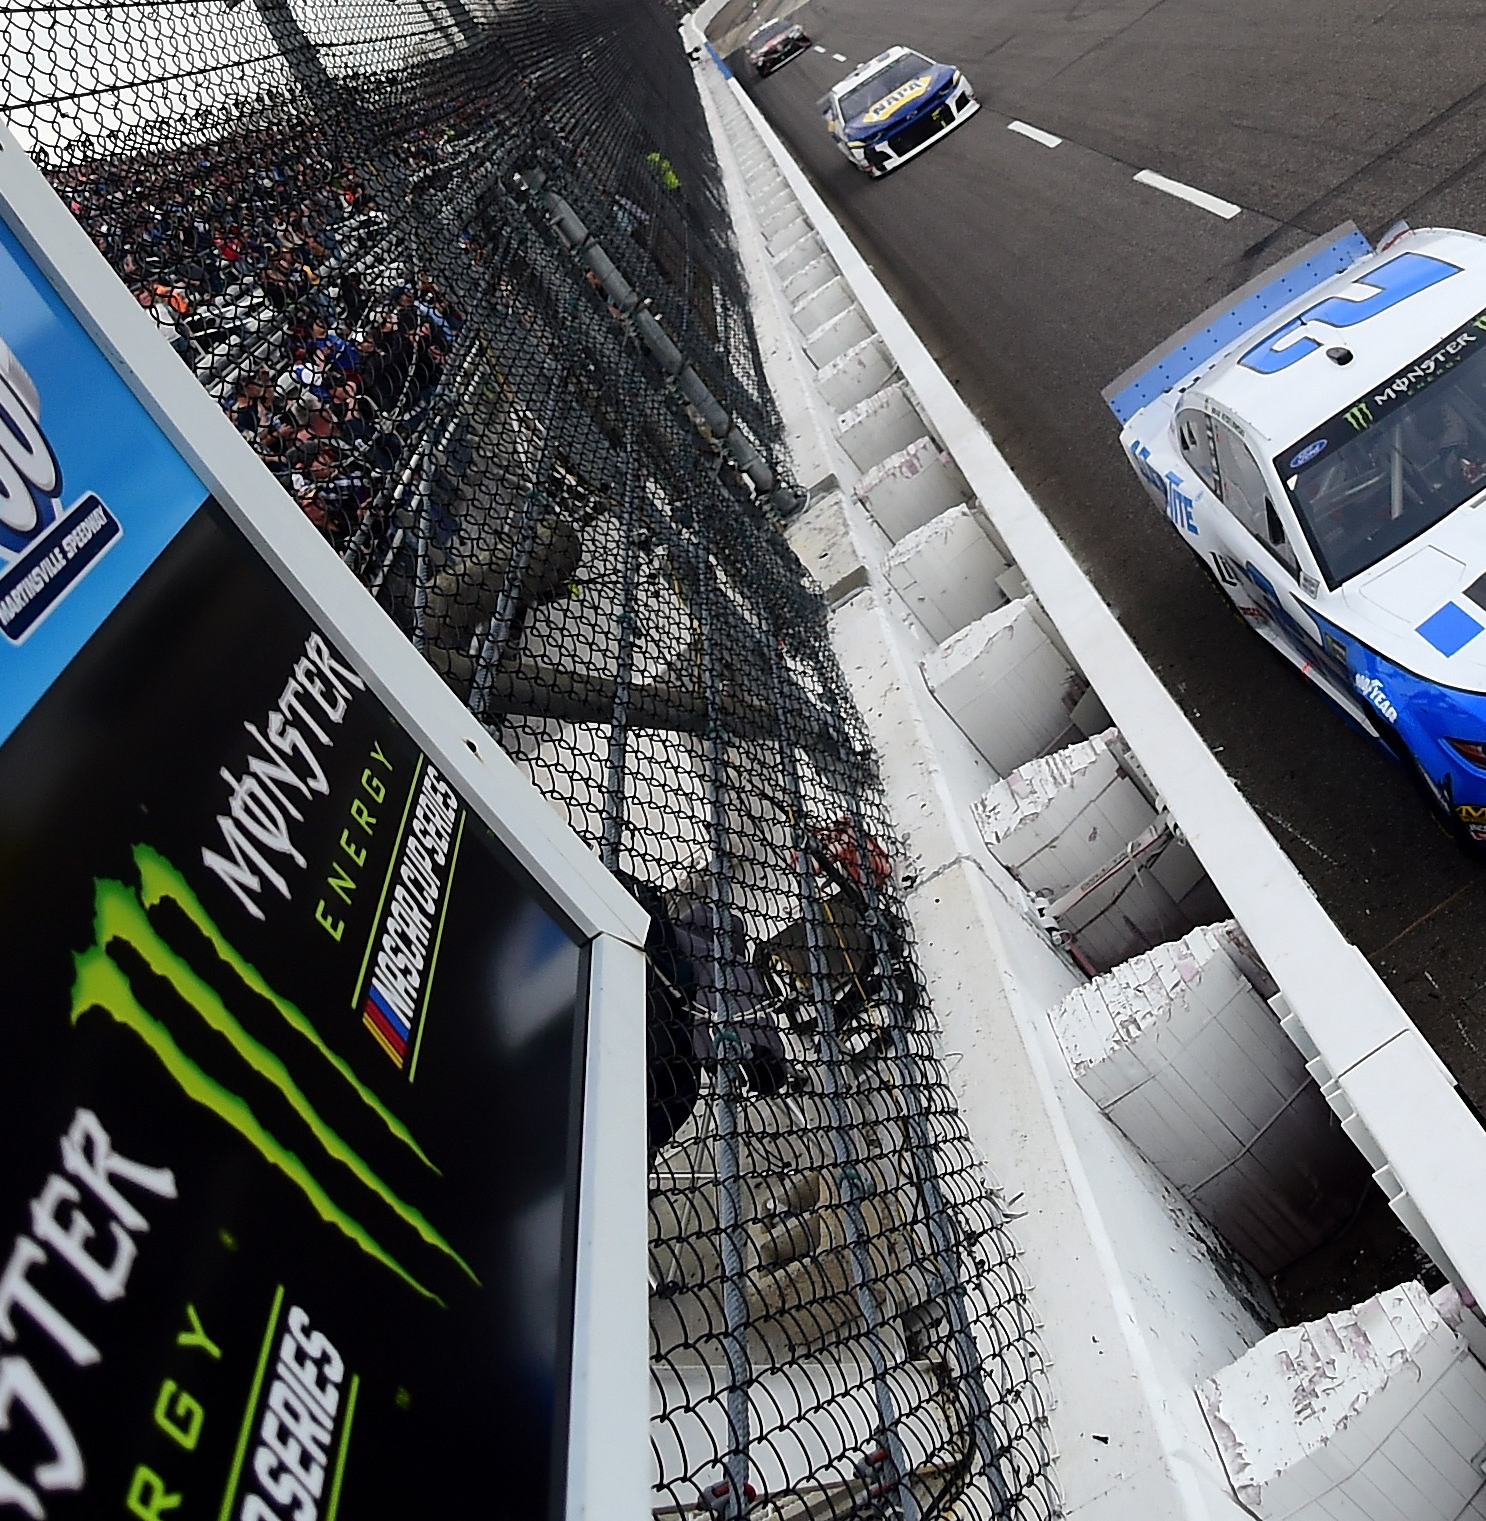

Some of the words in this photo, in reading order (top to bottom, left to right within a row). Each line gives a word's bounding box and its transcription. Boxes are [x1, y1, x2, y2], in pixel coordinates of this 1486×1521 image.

[874, 81, 923, 116] NAPA
[1373, 332, 1477, 406] MONSTER
[61, 505, 108, 561] SPEEDWAY
[201, 630, 367, 922] MONSTER
[413, 765, 458, 866] SERIES
[315, 740, 394, 942] ENERGY
[399, 835, 441, 921] CUP
[371, 883, 433, 1031] NASCAR
